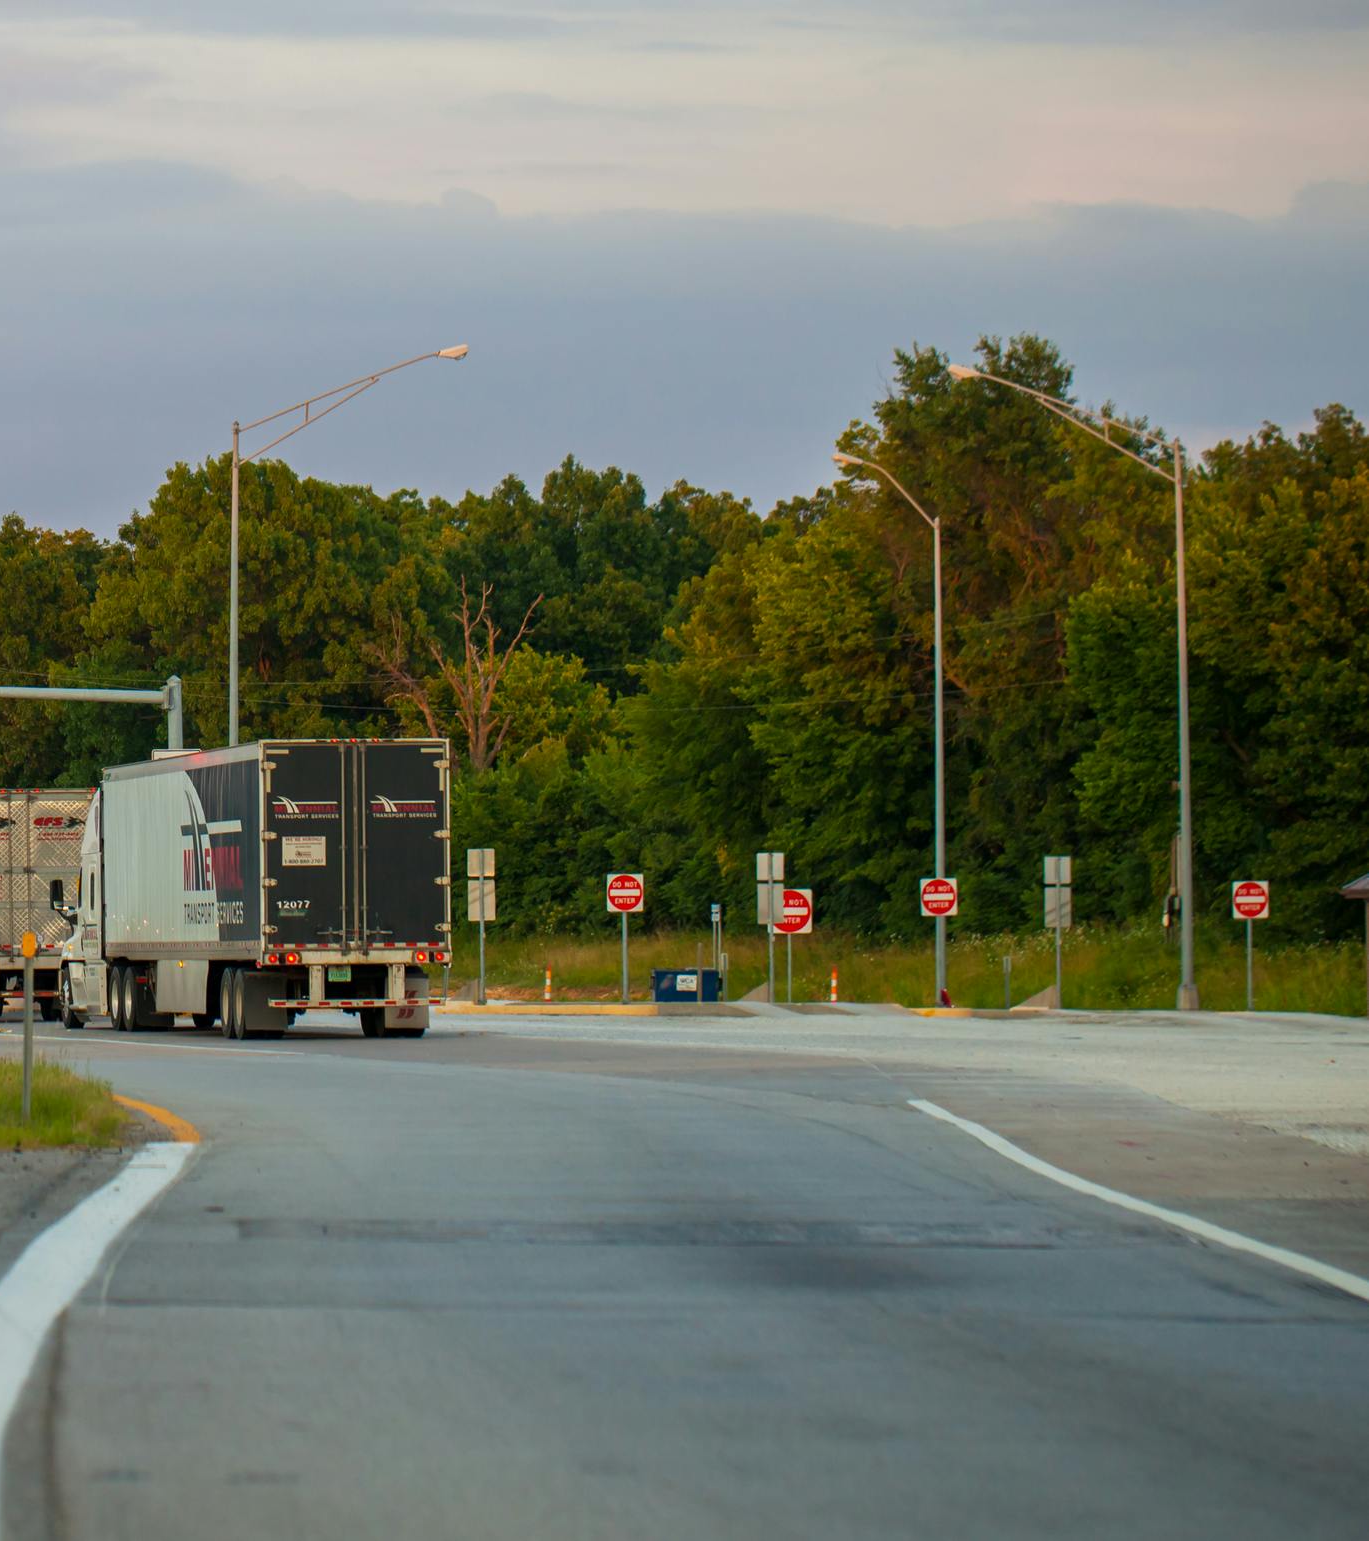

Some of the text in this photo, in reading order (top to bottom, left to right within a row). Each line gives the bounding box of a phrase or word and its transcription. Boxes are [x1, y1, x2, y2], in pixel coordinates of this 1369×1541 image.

[925, 885, 935, 893] DO
[276, 900, 311, 909] 12077
[615, 897, 636, 905] ENTER
[928, 901, 949, 909] ENTER
[184, 901, 244, 924] TRANSPORT SERVICES
[783, 917, 801, 925] NTER
